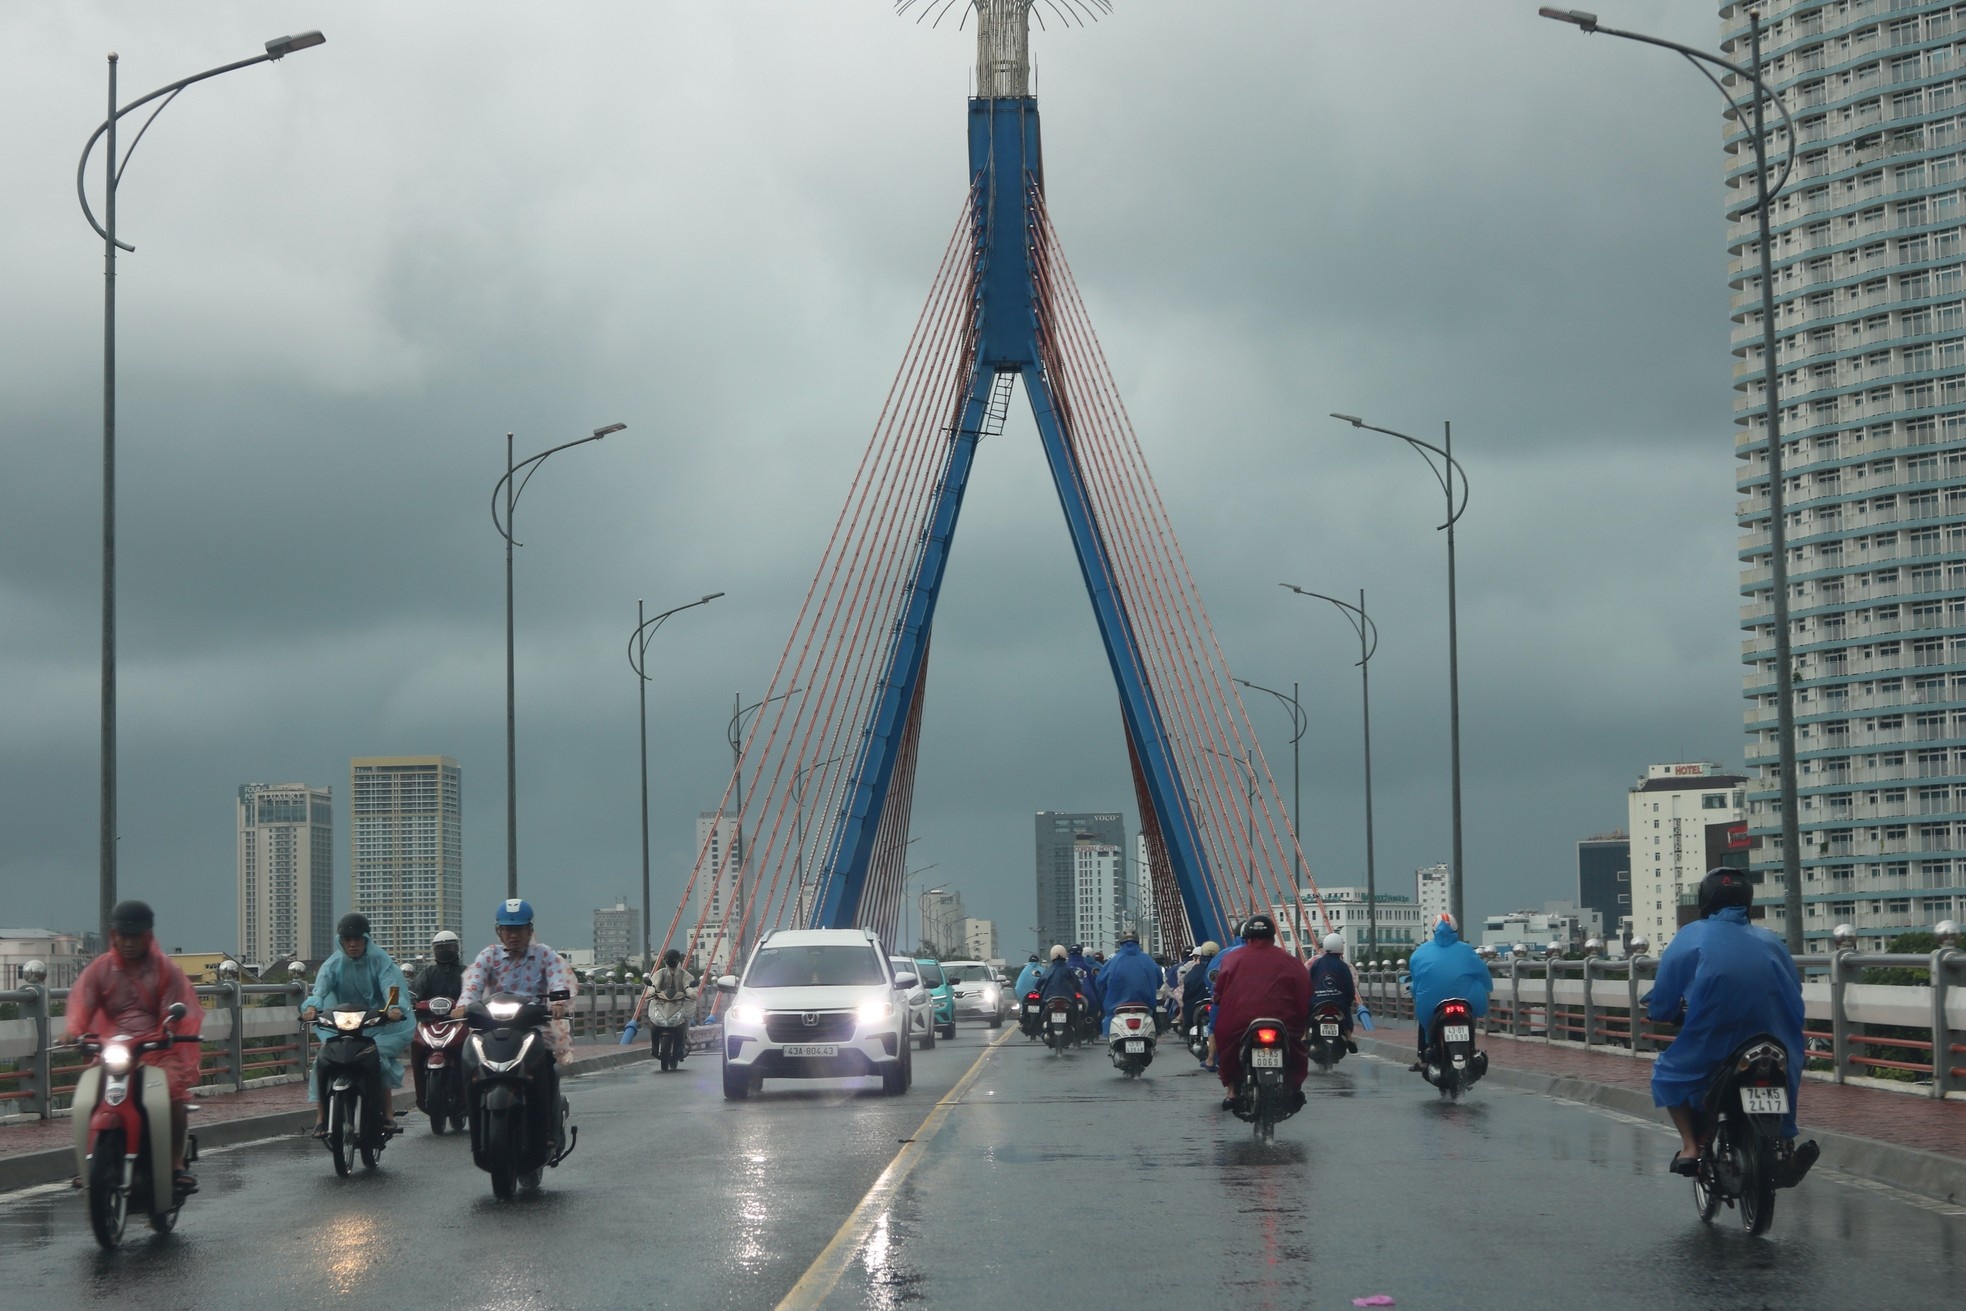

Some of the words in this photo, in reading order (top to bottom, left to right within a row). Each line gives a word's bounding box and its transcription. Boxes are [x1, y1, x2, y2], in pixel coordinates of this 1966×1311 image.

[1675, 765, 1703, 776] HOTEL
[264, 791, 302, 800] LUXURY
[1257, 1058, 1279, 1066] 0069
[1747, 1088, 1780, 1099] 74-K5
[1749, 1100, 1781, 1111] 2417
